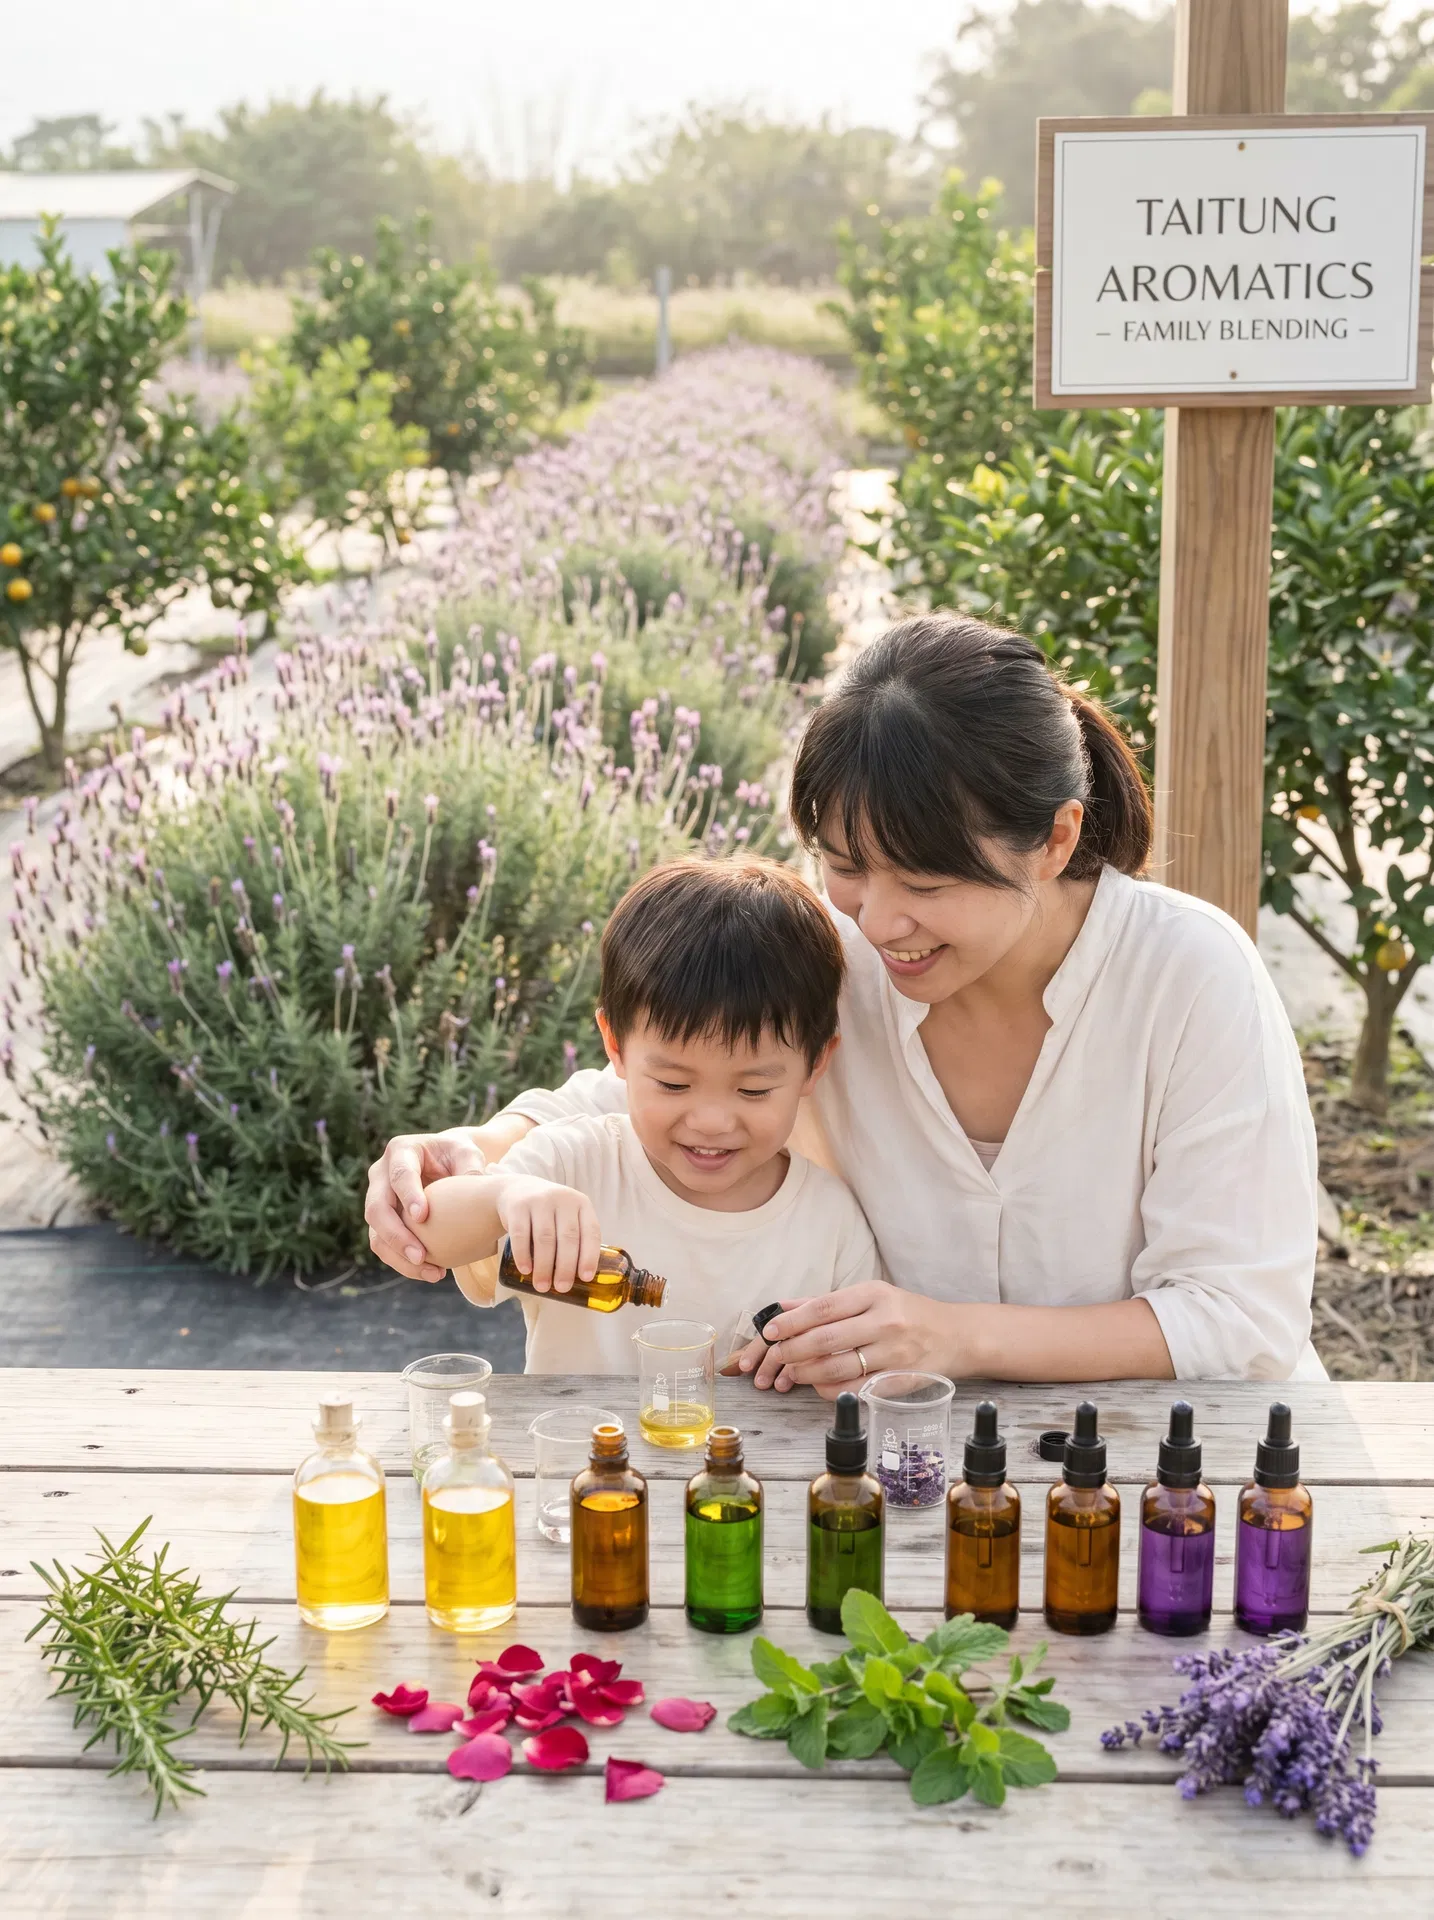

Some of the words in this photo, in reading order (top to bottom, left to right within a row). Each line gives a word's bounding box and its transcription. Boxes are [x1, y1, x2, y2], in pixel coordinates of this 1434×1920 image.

[1136, 195, 1336, 236] TAITUNG
[1096, 261, 1374, 303] AROMATICS
[1123, 320, 1212, 342] FAMILY
[1219, 317, 1349, 341] BLENDING
